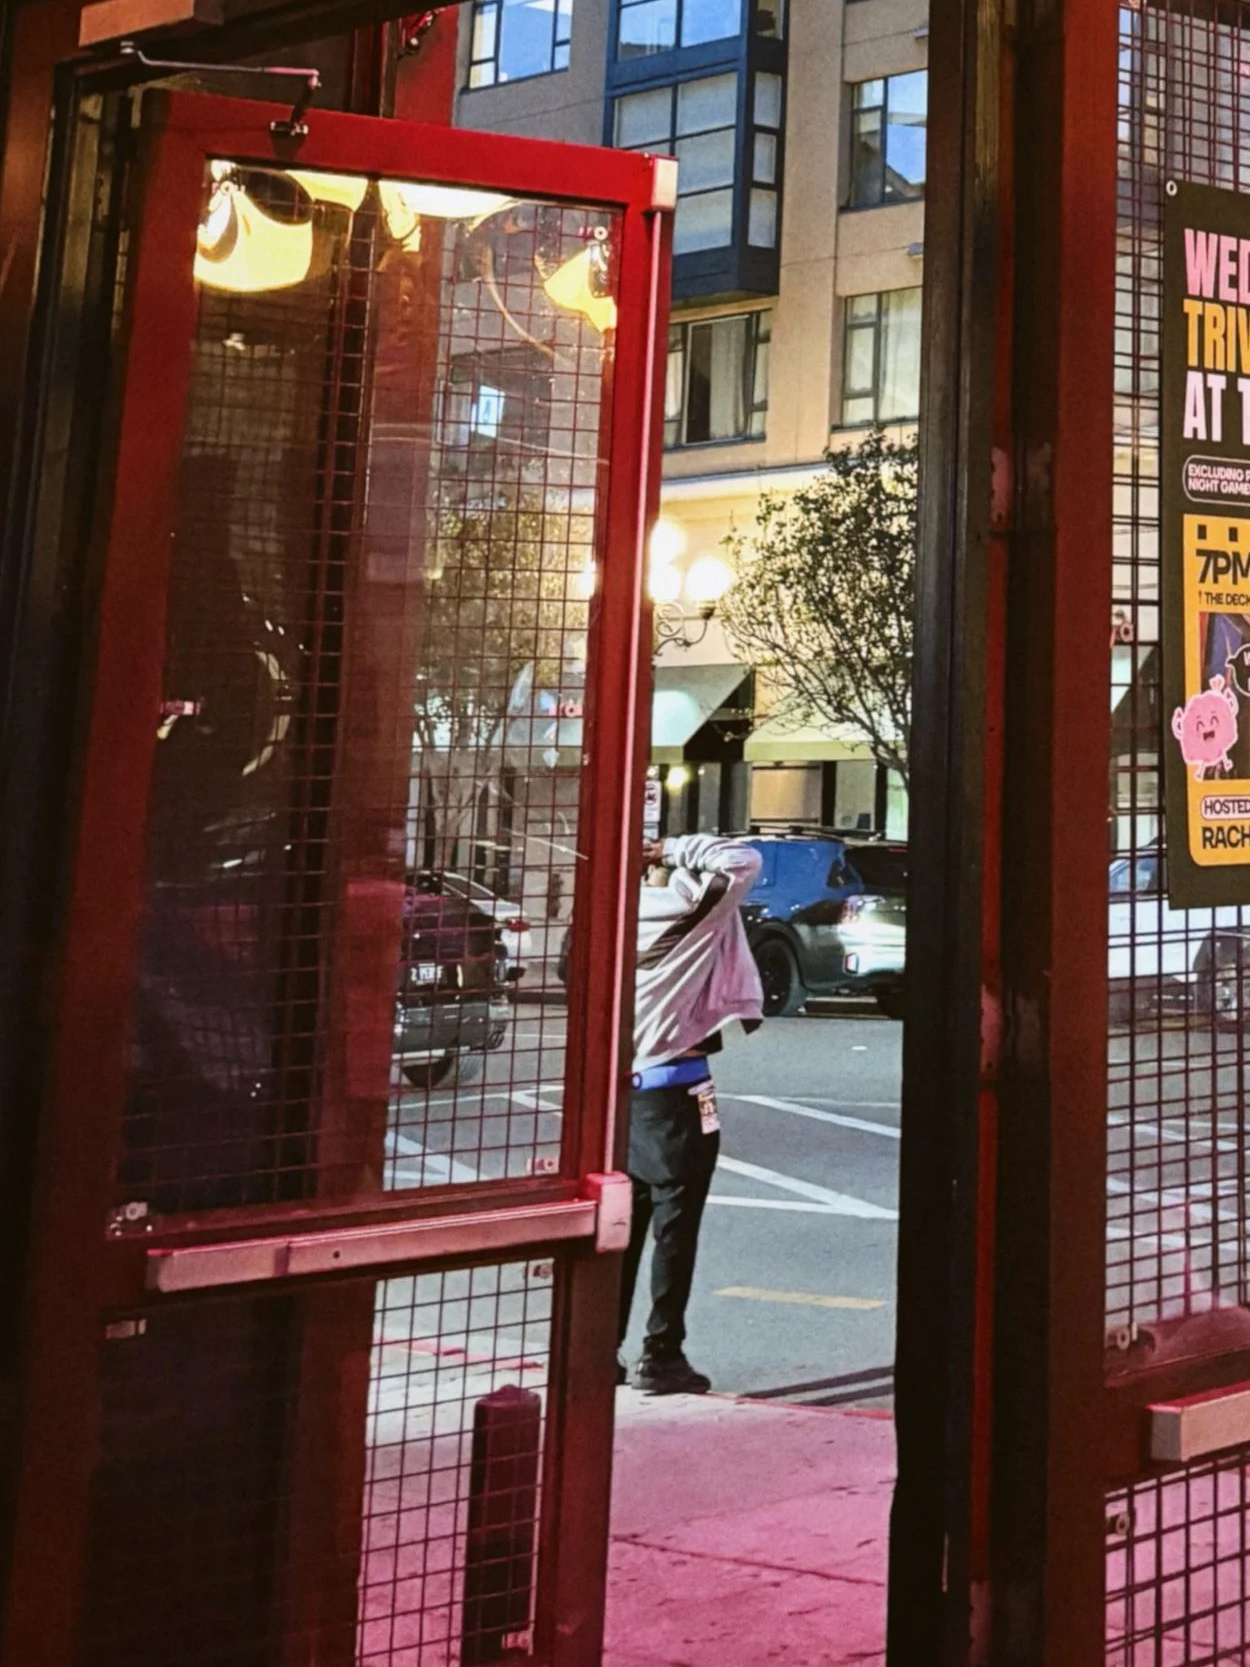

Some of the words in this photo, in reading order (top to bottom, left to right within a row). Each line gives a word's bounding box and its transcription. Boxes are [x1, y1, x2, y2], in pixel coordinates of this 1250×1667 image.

[1183, 370, 1227, 442] AT
[1188, 464, 1244, 481] EXCLUDING
[1188, 478, 1219, 492] NIGHT
[1205, 592, 1223, 605] THE
